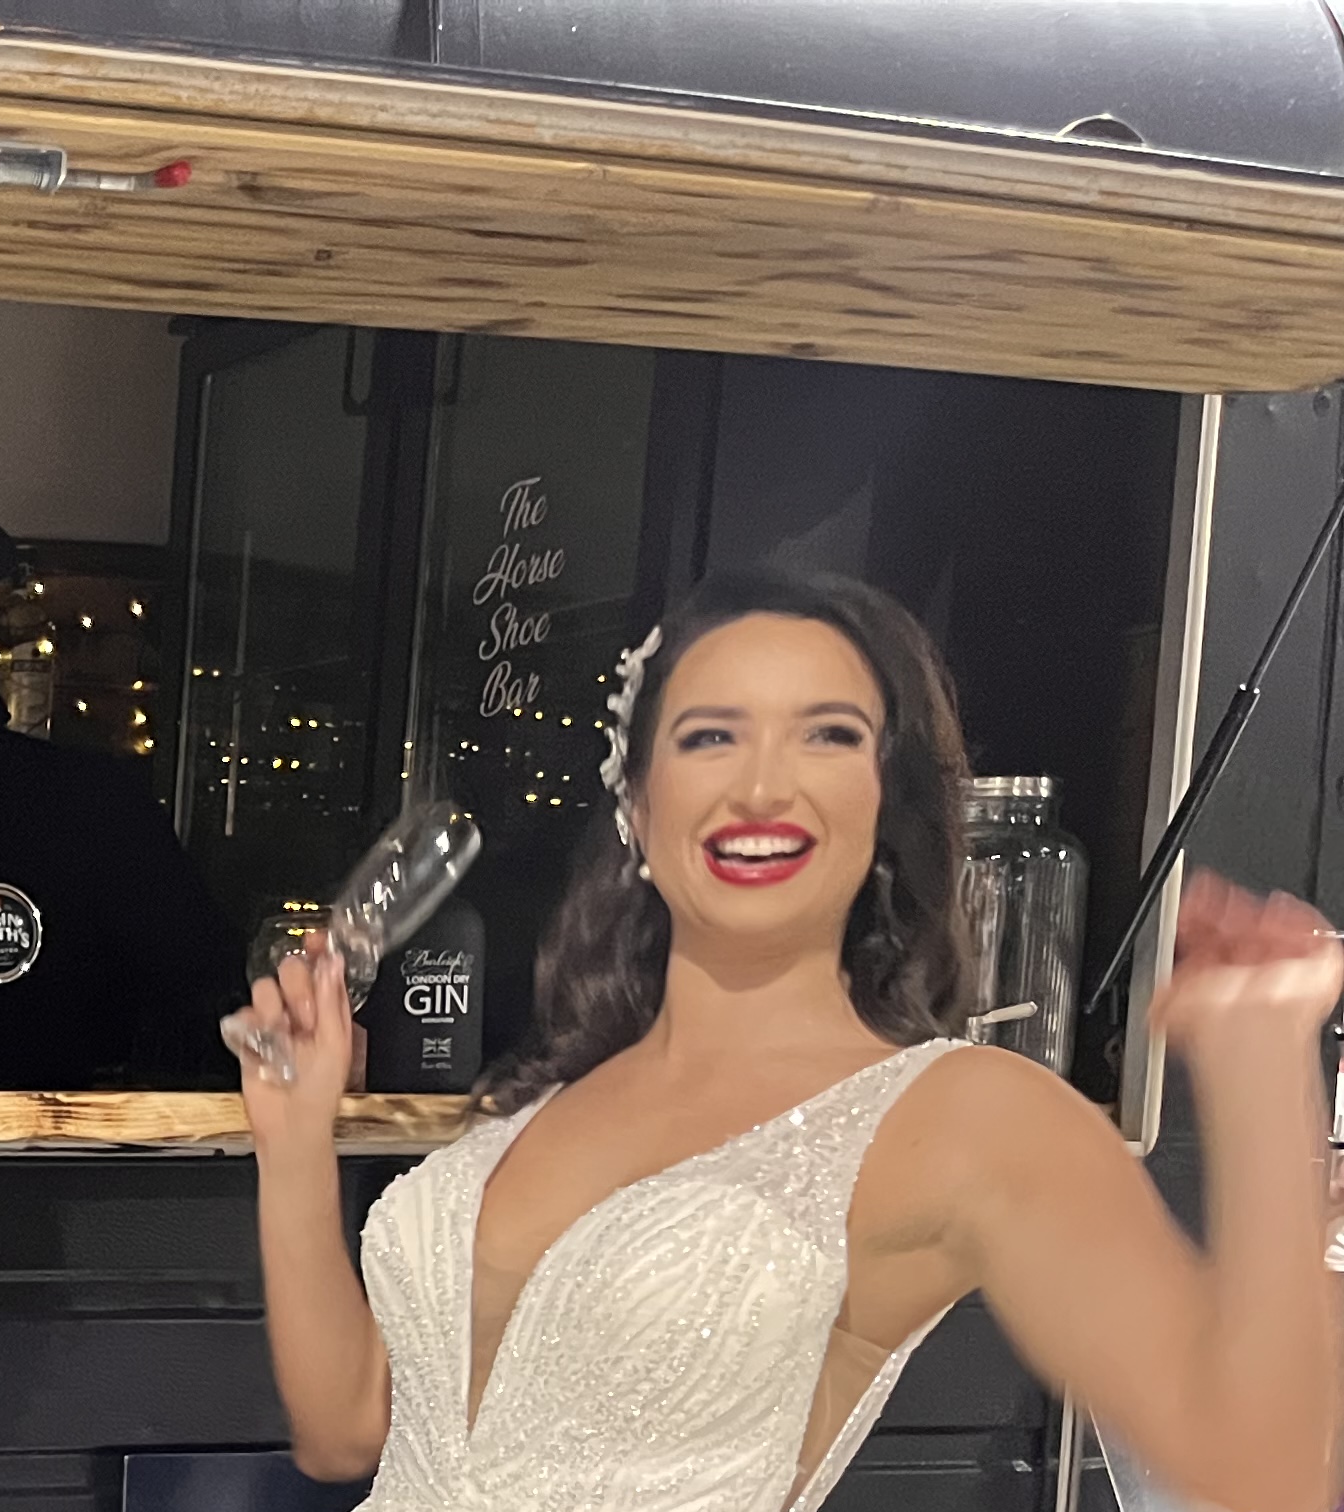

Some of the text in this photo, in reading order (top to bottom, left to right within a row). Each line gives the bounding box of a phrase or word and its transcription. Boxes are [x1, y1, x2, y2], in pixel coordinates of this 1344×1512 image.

[500, 476, 547, 538] The
[473, 543, 565, 605] Horse
[479, 602, 552, 661] Shoe
[480, 660, 541, 717] Bar
[403, 985, 468, 1015] GIN
[406, 975, 470, 985] LONDON DRY
